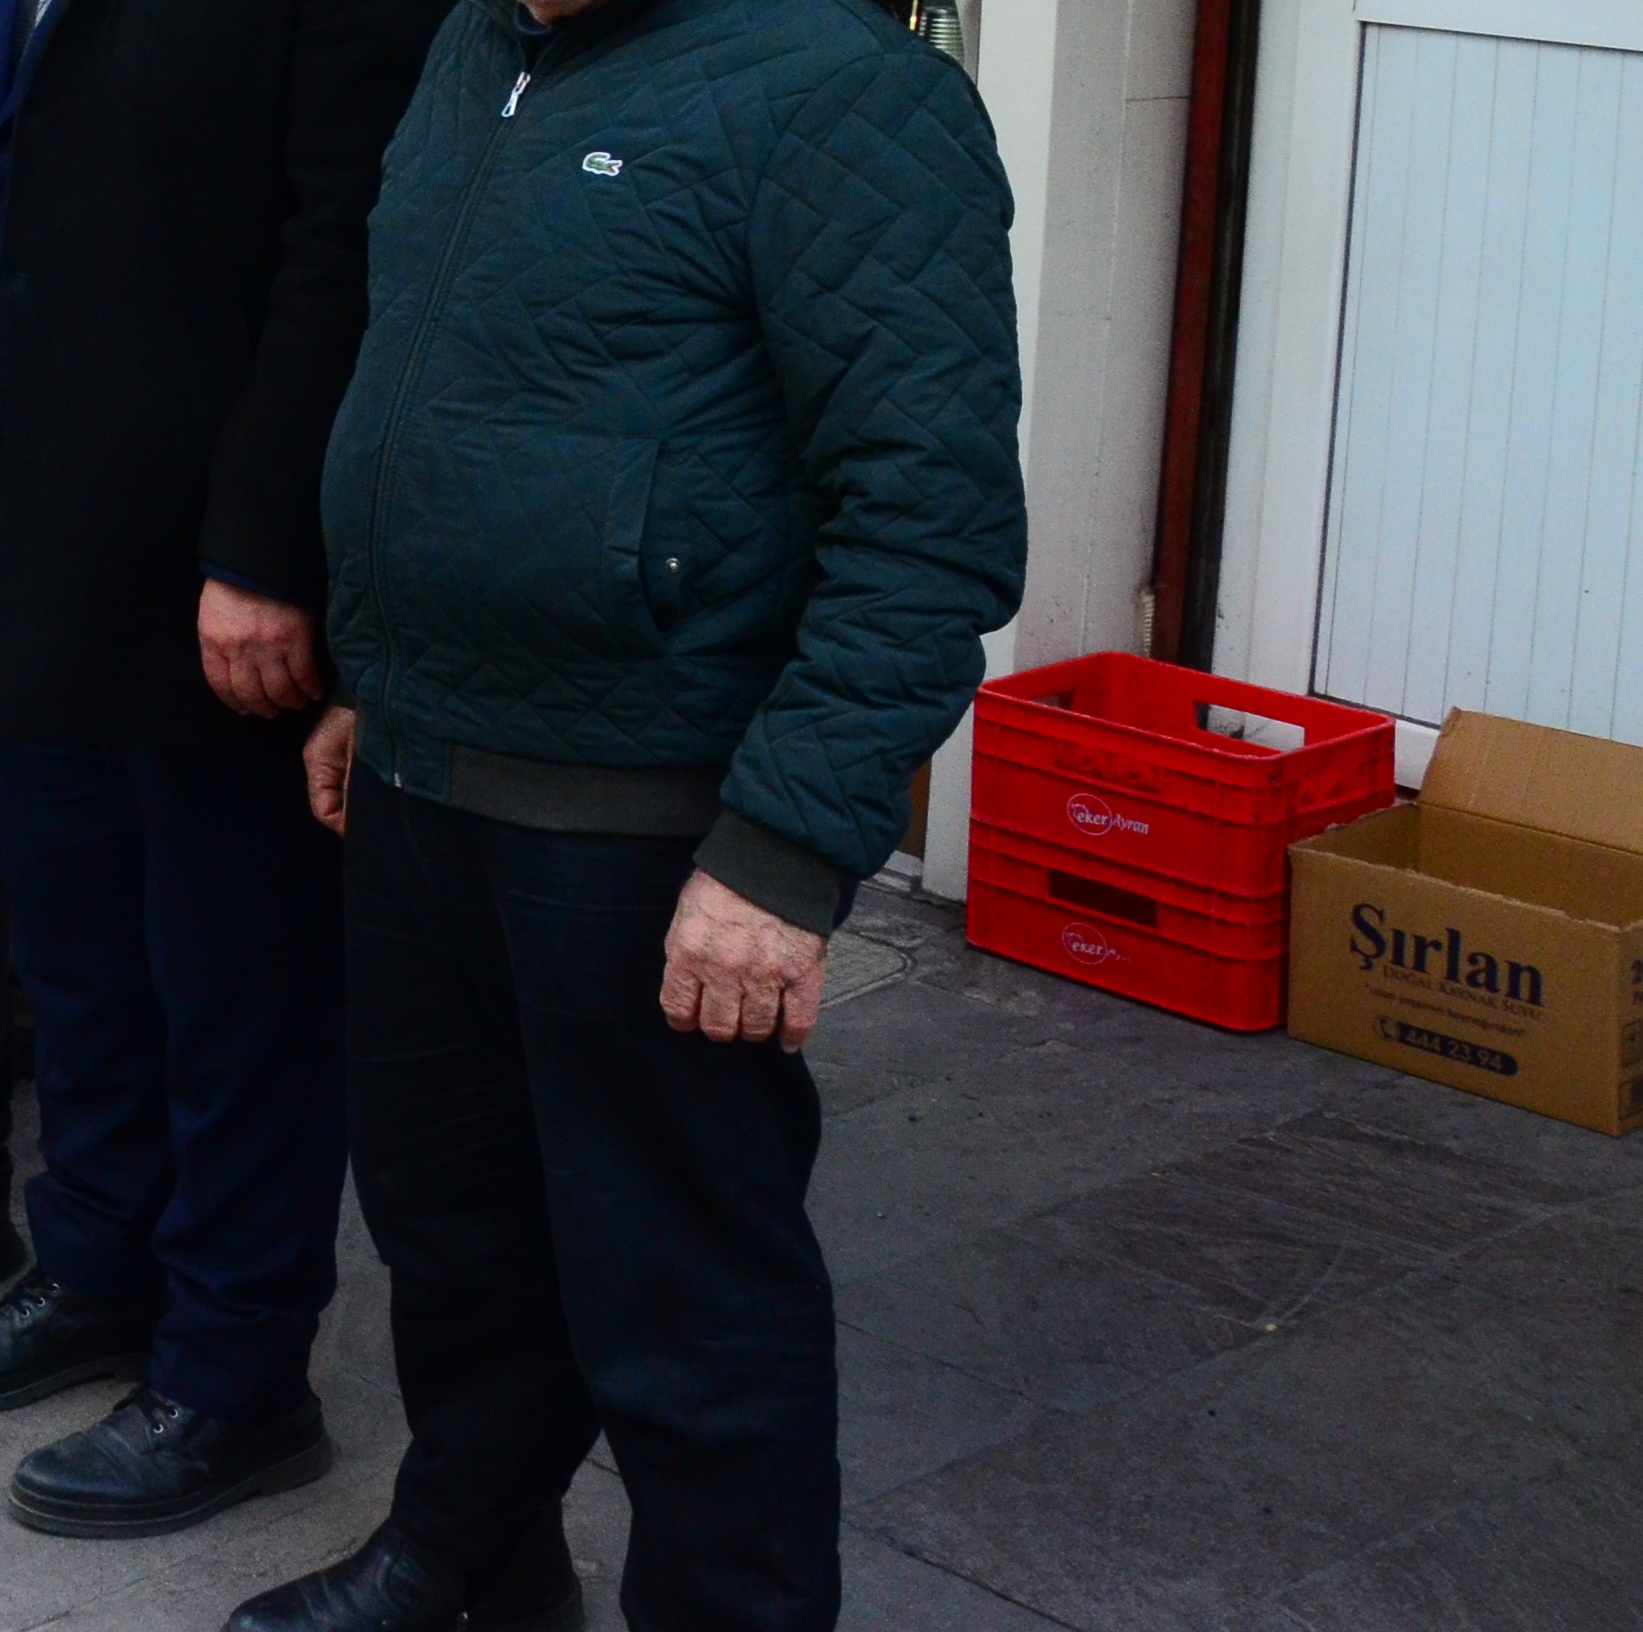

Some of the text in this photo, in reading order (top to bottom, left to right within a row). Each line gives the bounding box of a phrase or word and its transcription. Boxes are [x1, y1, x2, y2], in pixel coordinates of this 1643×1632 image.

[1350, 902, 1545, 1008] Şırlan
[1446, 1040, 1472, 1062] 23
[1478, 1049, 1503, 1072] 94
